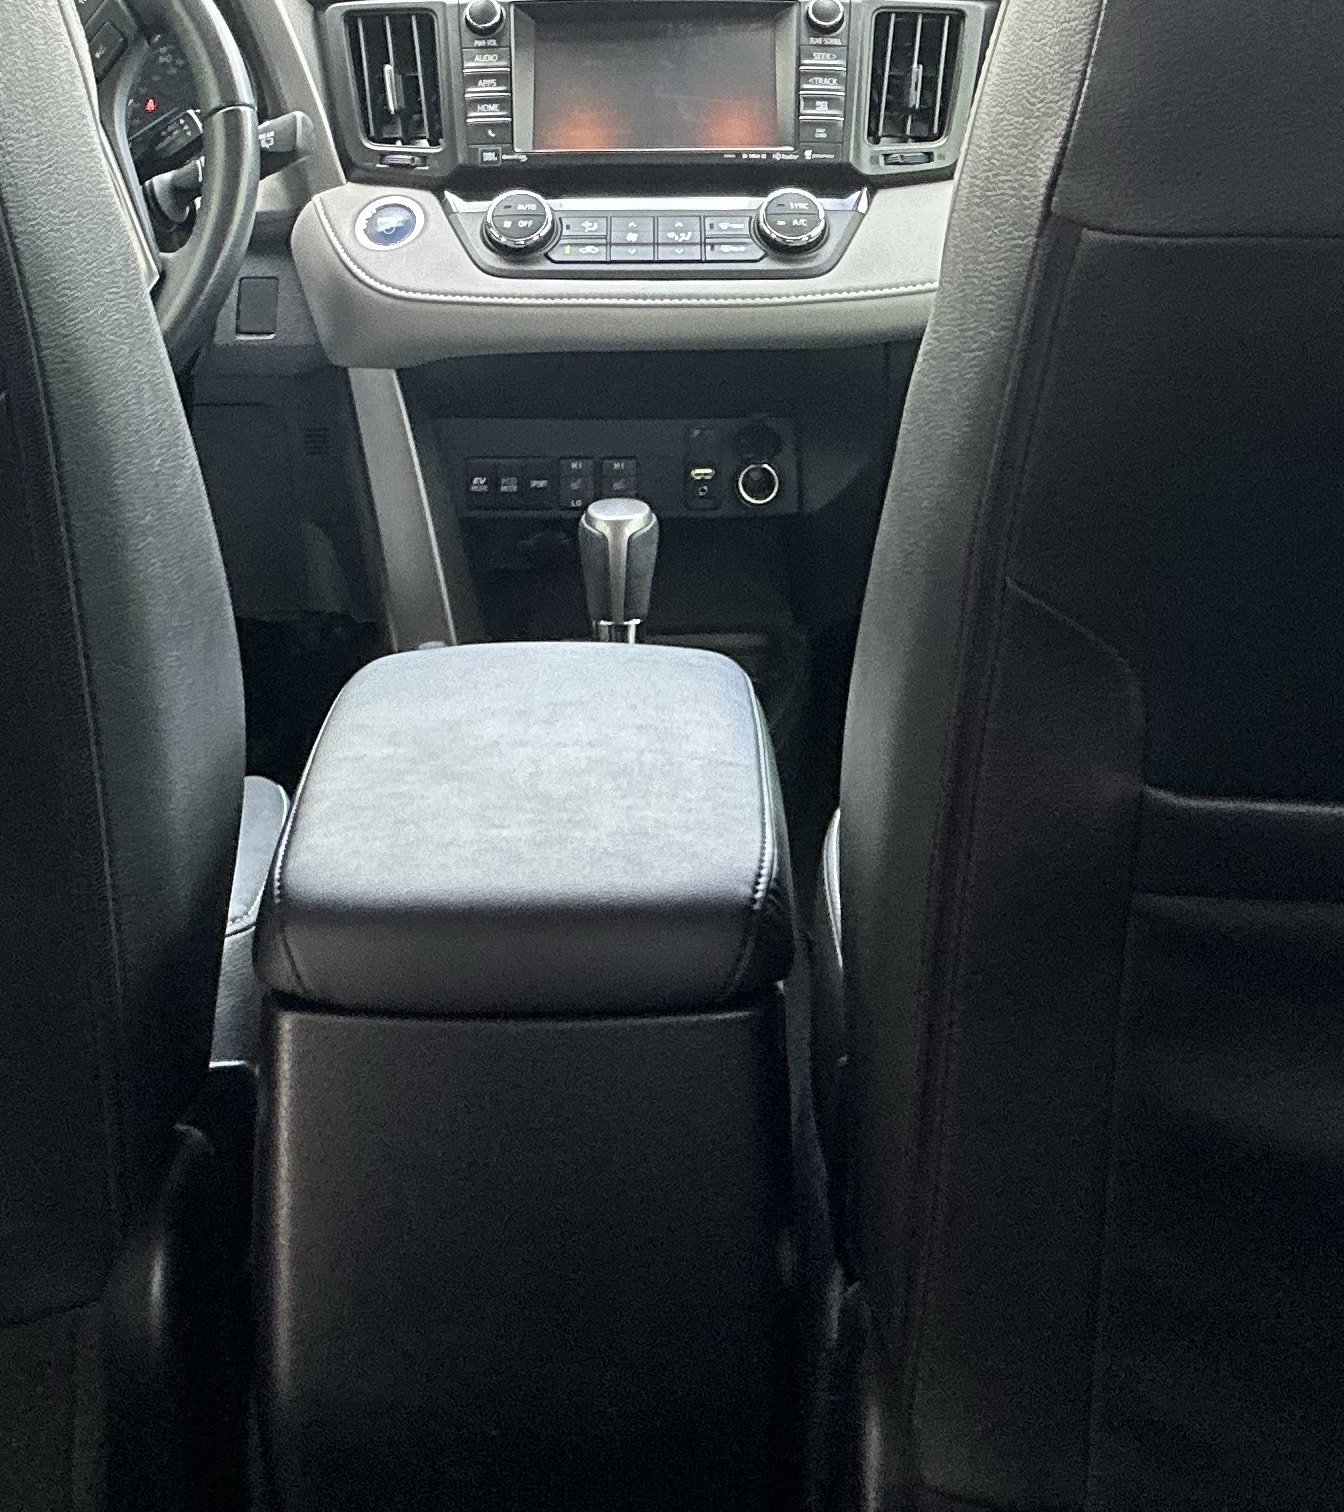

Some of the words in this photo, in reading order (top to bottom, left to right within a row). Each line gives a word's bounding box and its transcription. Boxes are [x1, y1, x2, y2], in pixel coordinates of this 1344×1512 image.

[474, 53, 499, 62] AUDIO
[477, 79, 497, 87] APPS
[814, 77, 838, 86] TRACK
[477, 104, 500, 112] HOME
[516, 203, 537, 212] AUTO
[518, 219, 534, 228] OFF
[792, 219, 808, 227] A/C
